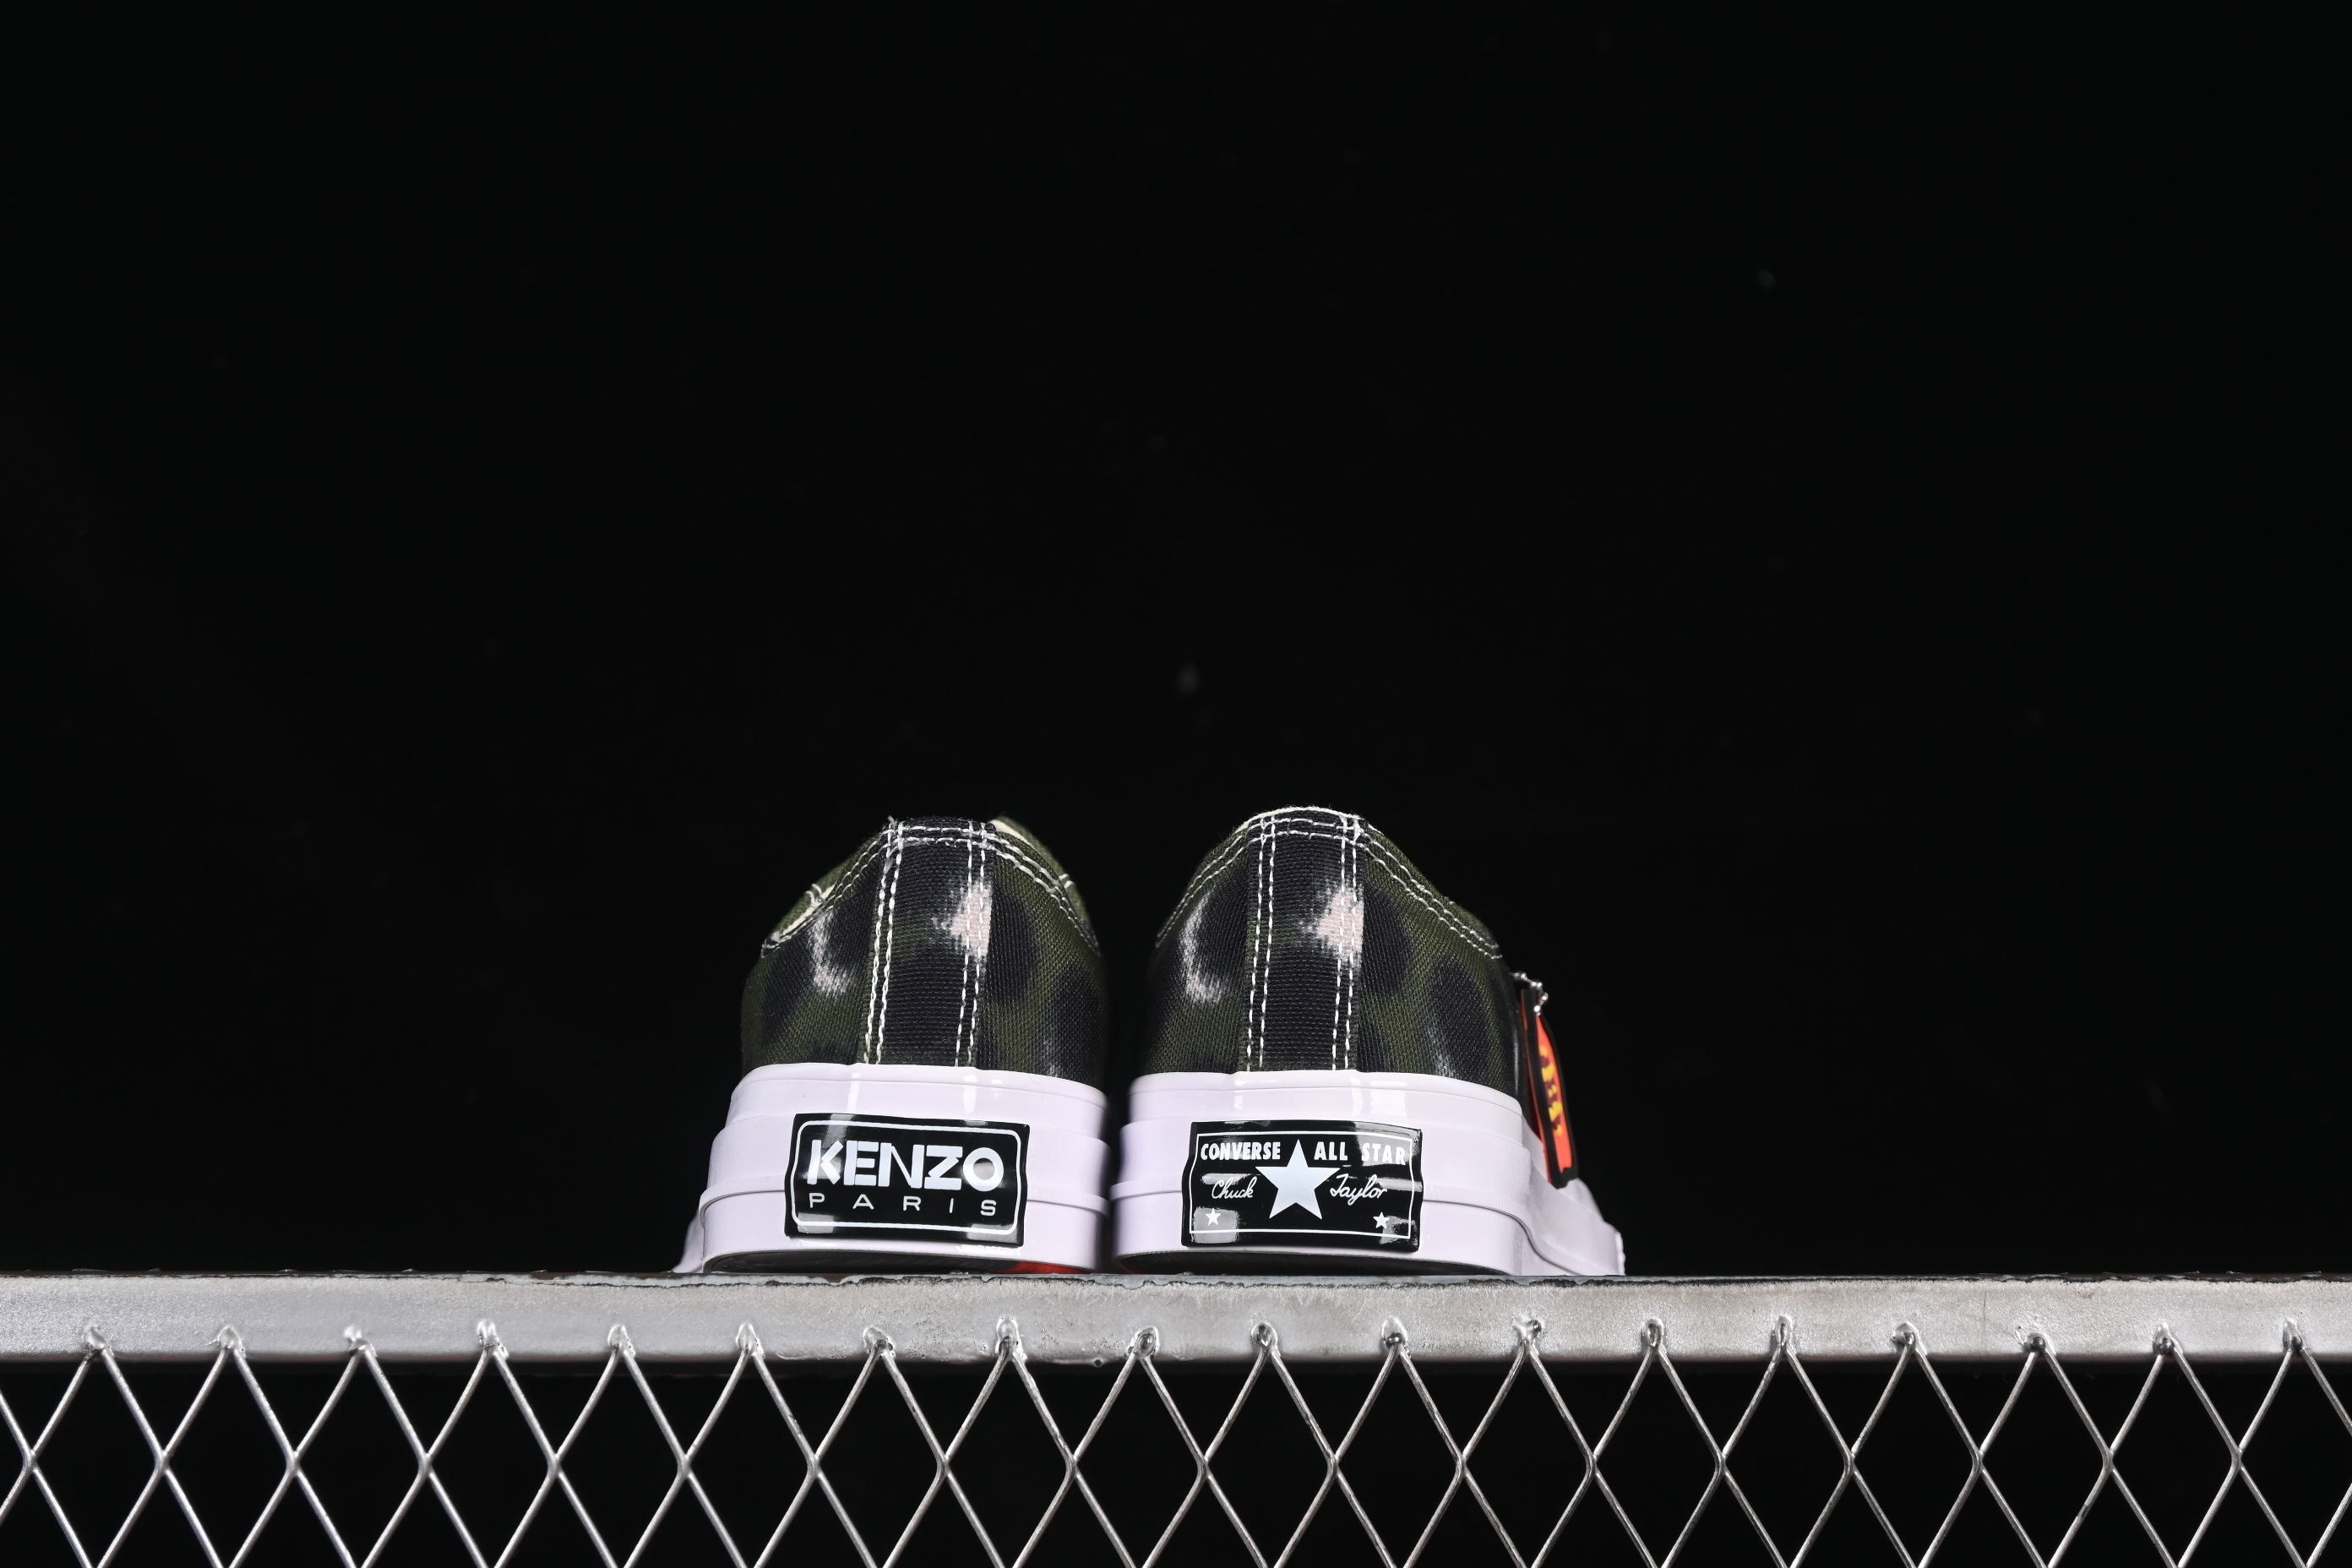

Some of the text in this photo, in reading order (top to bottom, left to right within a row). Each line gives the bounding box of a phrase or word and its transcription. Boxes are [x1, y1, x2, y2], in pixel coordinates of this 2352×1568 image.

[807, 1139, 1004, 1192] KENZO
[1200, 1141, 1407, 1165] CONVERSE ALL STAR
[1211, 1174, 1388, 1206] Chuck Taylor
[808, 1192, 998, 1217] PARIS
